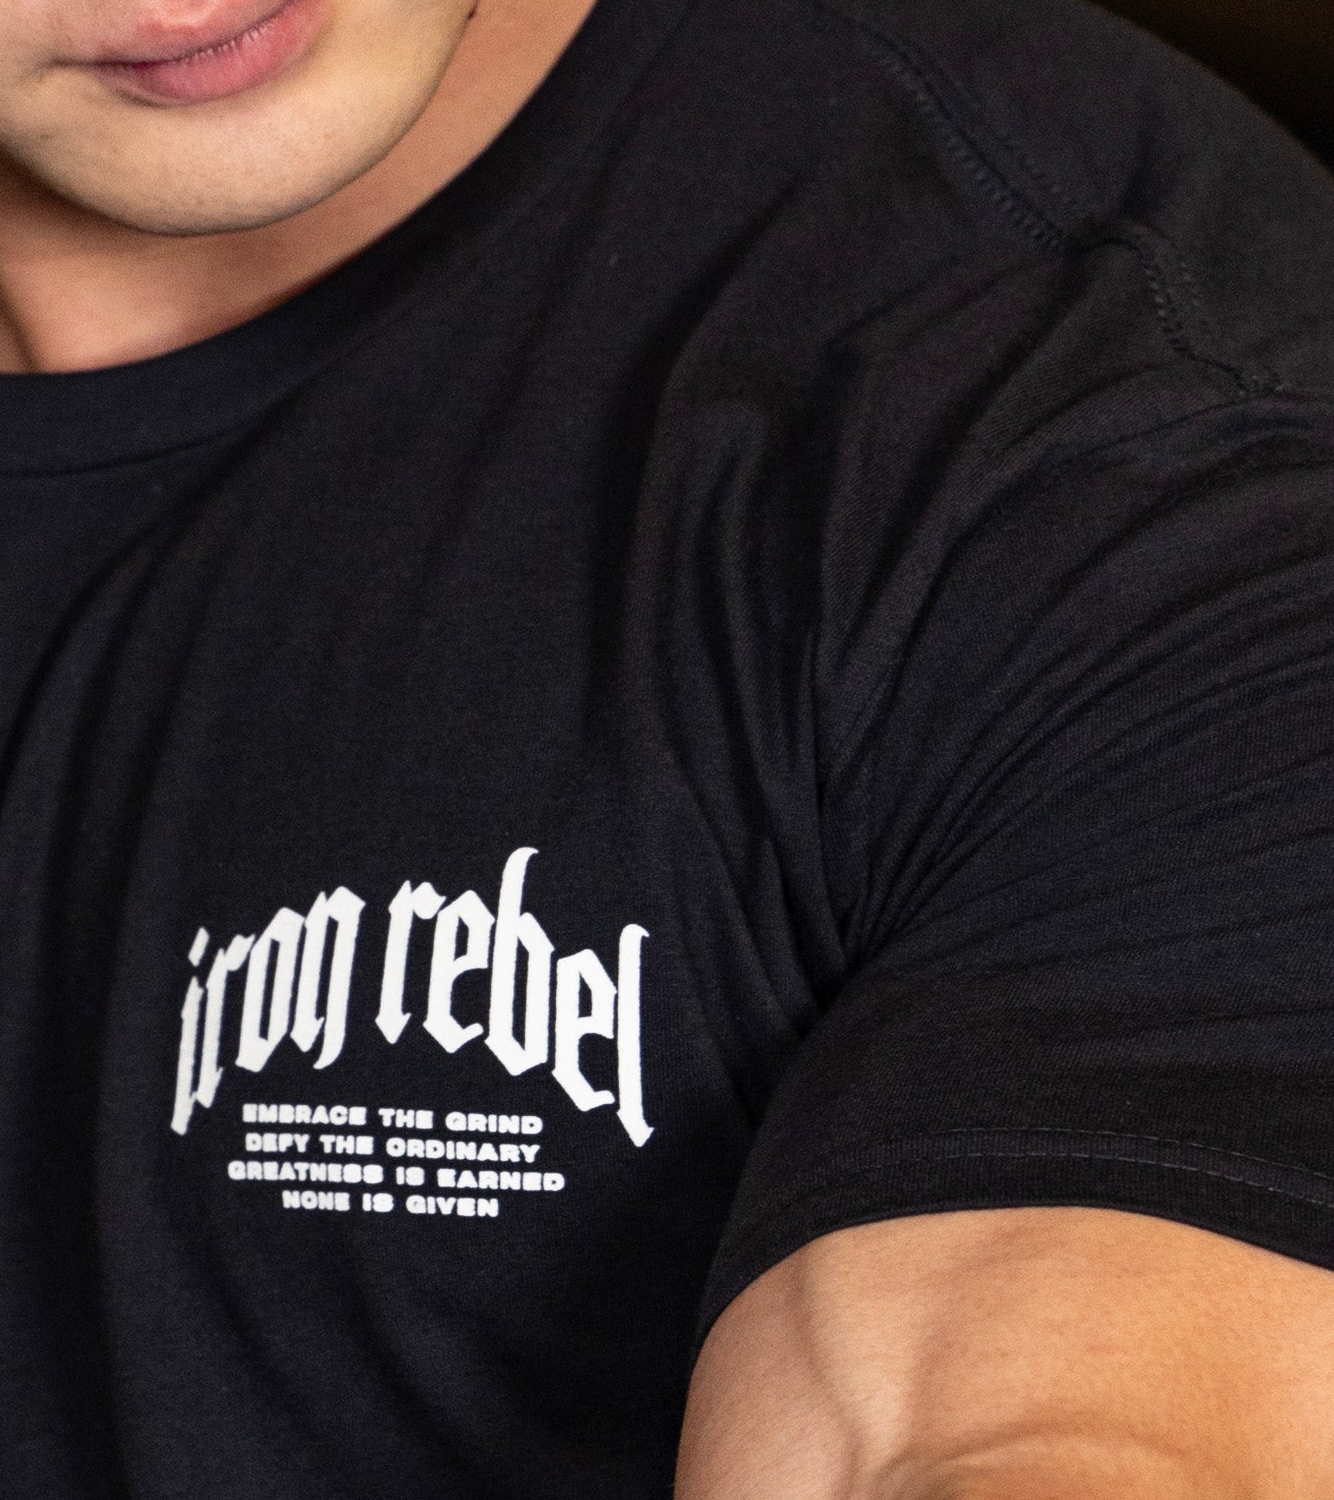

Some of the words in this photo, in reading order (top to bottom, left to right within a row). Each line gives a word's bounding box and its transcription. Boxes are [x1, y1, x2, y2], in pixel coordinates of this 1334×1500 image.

[170, 885, 366, 1136] iron
[375, 846, 655, 1148] rebel
[242, 1103, 367, 1125] EMBRACE
[378, 1107, 433, 1129] THE
[445, 1111, 544, 1134] GRIND
[245, 1132, 310, 1153] DEFY
[319, 1134, 374, 1155] THE
[385, 1137, 541, 1162] ORDINARY
[227, 1160, 384, 1184] GREATNESS
[396, 1166, 425, 1186] IS
[437, 1168, 566, 1191] EARNED
[282, 1190, 350, 1211] NONE
[362, 1193, 394, 1212] IS
[405, 1195, 499, 1217] GIVEN
